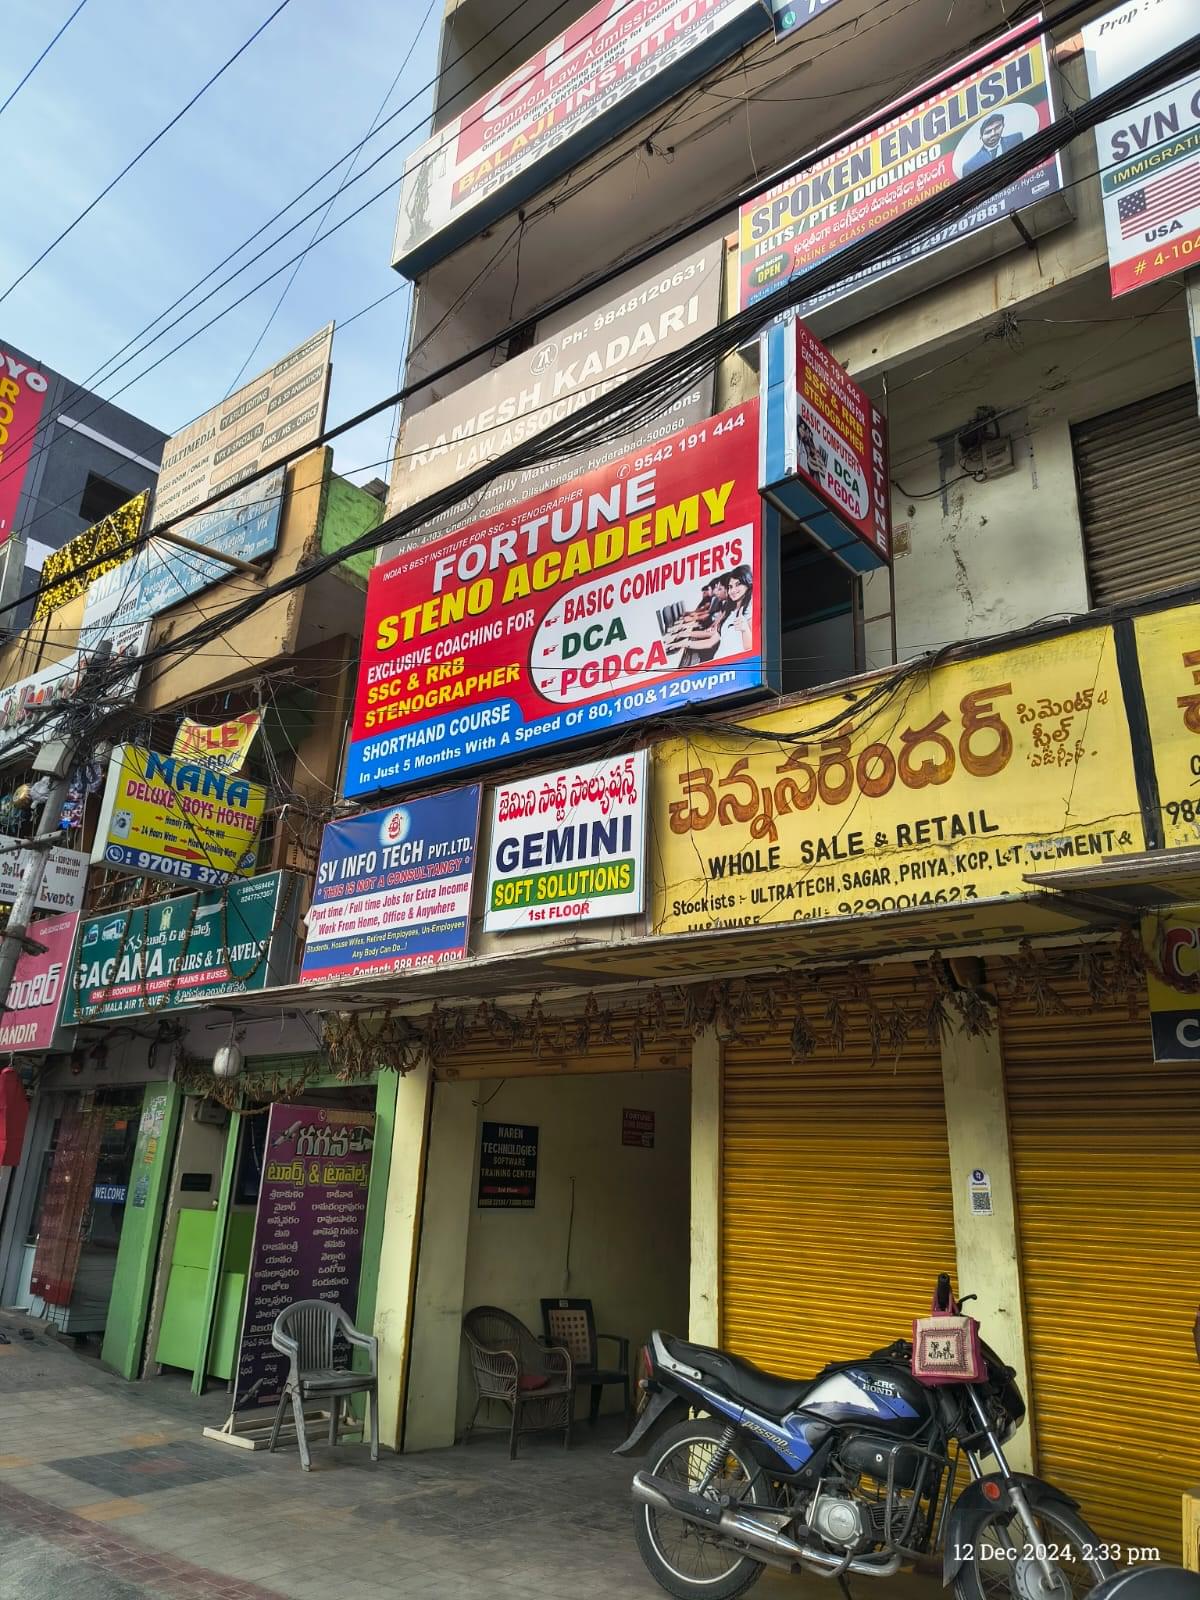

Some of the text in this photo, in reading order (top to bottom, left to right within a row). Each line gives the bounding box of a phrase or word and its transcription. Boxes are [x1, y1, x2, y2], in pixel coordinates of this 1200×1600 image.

[1099, 7, 1138, 36] Prop
[603, 47, 627, 72] 2024
[604, 71, 633, 94] Work
[459, 0, 722, 193] BALAJI INSTITU
[483, 63, 579, 141] Common Law
[751, 147, 872, 240] SPOKEN
[880, 51, 1033, 172] ENGLISH
[1110, 102, 1180, 162] SVN
[754, 226, 795, 259] IELTS
[809, 203, 838, 230] PTE
[853, 143, 942, 202] DUOLINGO
[795, 245, 826, 267] ONLINE
[840, 220, 866, 243] CLASS
[869, 204, 901, 231] ROOM
[902, 178, 952, 211] TRAINING
[1144, 219, 1184, 243] USA
[593, 258, 707, 334] 9848120631
[757, 262, 781, 284] OPEN
[408, 381, 542, 474] RAMESH
[552, 295, 699, 399] KADARI
[803, 365, 865, 439] SSC RRB
[588, 418, 686, 472] Hyderabad-500060
[633, 412, 746, 471] 9542 191 444
[801, 403, 821, 437] BASIC
[803, 382, 865, 456] STENOGRAPHER
[160, 426, 217, 476] MULTIMEDIA
[456, 438, 494, 472] LAW
[833, 457, 861, 498] DCA
[827, 474, 862, 519] PGDCA
[871, 407, 888, 553] FORTUNE
[410, 552, 429, 571] BEST
[429, 539, 470, 562] INSTITUTE
[470, 531, 487, 549] FOR
[487, 523, 505, 541] SSC
[511, 488, 584, 527] STENOGRAPHER
[433, 467, 658, 595] FORTUNE
[376, 478, 737, 652] STENO ACADEMY
[562, 537, 745, 626] BASIC COMPUTER'S
[367, 608, 536, 685] EXCLUSIVE COACHING FOR
[560, 615, 629, 662] DCA
[366, 655, 466, 706] SSC & RRB
[559, 638, 669, 697] PGDCA
[363, 661, 521, 729] STENOGRAPHER
[359, 773, 370, 785] In
[373, 761, 400, 782] Just
[402, 757, 412, 772] 5
[414, 746, 462, 771] Months
[464, 734, 497, 757] With
[500, 731, 512, 747] A
[514, 716, 562, 745] Speed
[564, 709, 584, 730] Of
[362, 693, 512, 764] SHORTHAND COURSE
[126, 780, 176, 809] DELUXE
[182, 795, 214, 821] BOYS
[216, 806, 257, 833] HOSTEL
[145, 751, 250, 809] MANA
[137, 854, 193, 879] 97015
[319, 860, 339, 888] SV
[341, 849, 377, 880] INFO
[382, 840, 424, 874] TECH
[495, 813, 633, 874] GEMINI
[708, 808, 1000, 880] WHOLE SALE & RETAIL
[311, 880, 470, 925] Part time Full time Jobs for Extra Income
[494, 863, 632, 908] SOFT SOLUTIONS
[528, 902, 591, 921] 1st FLOOR
[672, 892, 736, 918] Stockists
[318, 898, 457, 938] Work From Home, Office Anywhere
[482, 1142, 538, 1157] TECHNOLOGIES
[498, 1127, 524, 1140] NAREN
[94, 1186, 126, 1201] WELCOME
[309, 1163, 320, 1185] &
